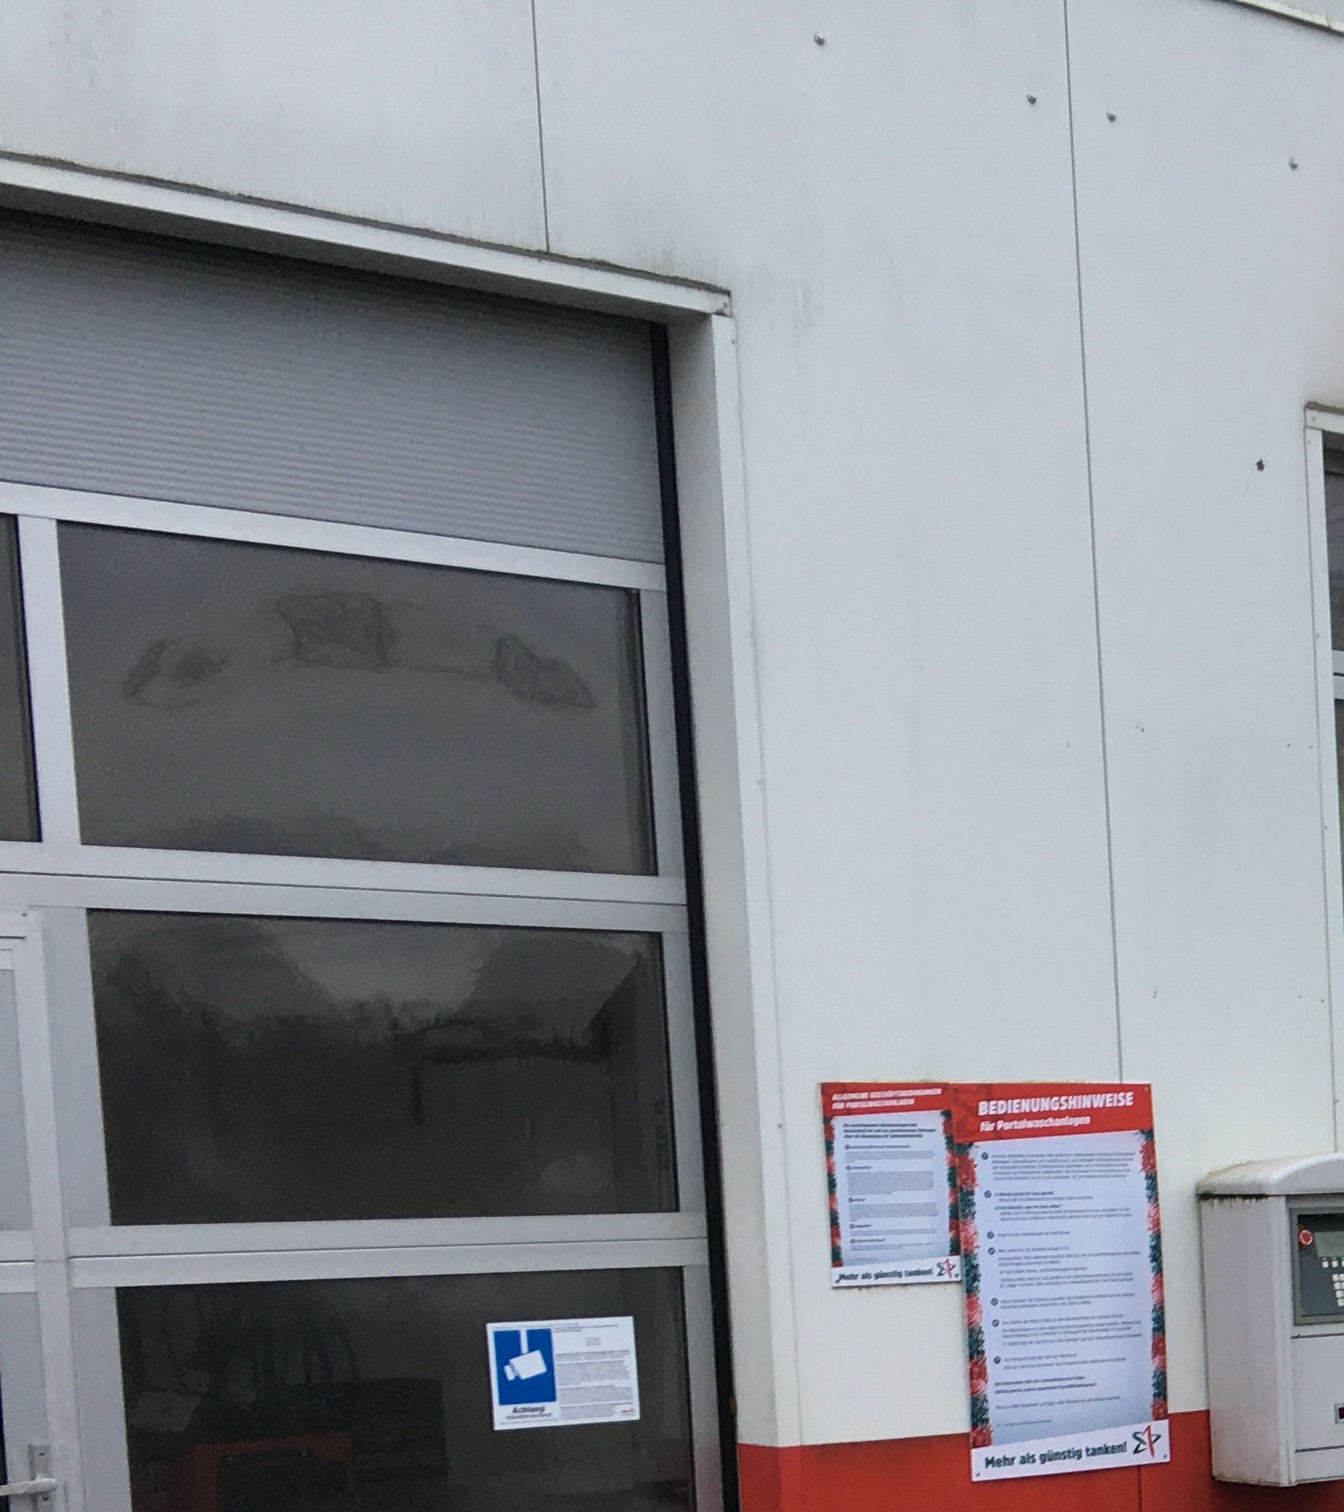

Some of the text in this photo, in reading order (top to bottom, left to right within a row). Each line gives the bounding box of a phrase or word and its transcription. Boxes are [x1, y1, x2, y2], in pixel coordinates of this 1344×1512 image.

[978, 1091, 1134, 1116] BEDIENUNGSHINWEISE
[980, 1115, 1091, 1132] für Portalwaschanlagen
[984, 1441, 1127, 1469] Mehr als günstig tanken!
